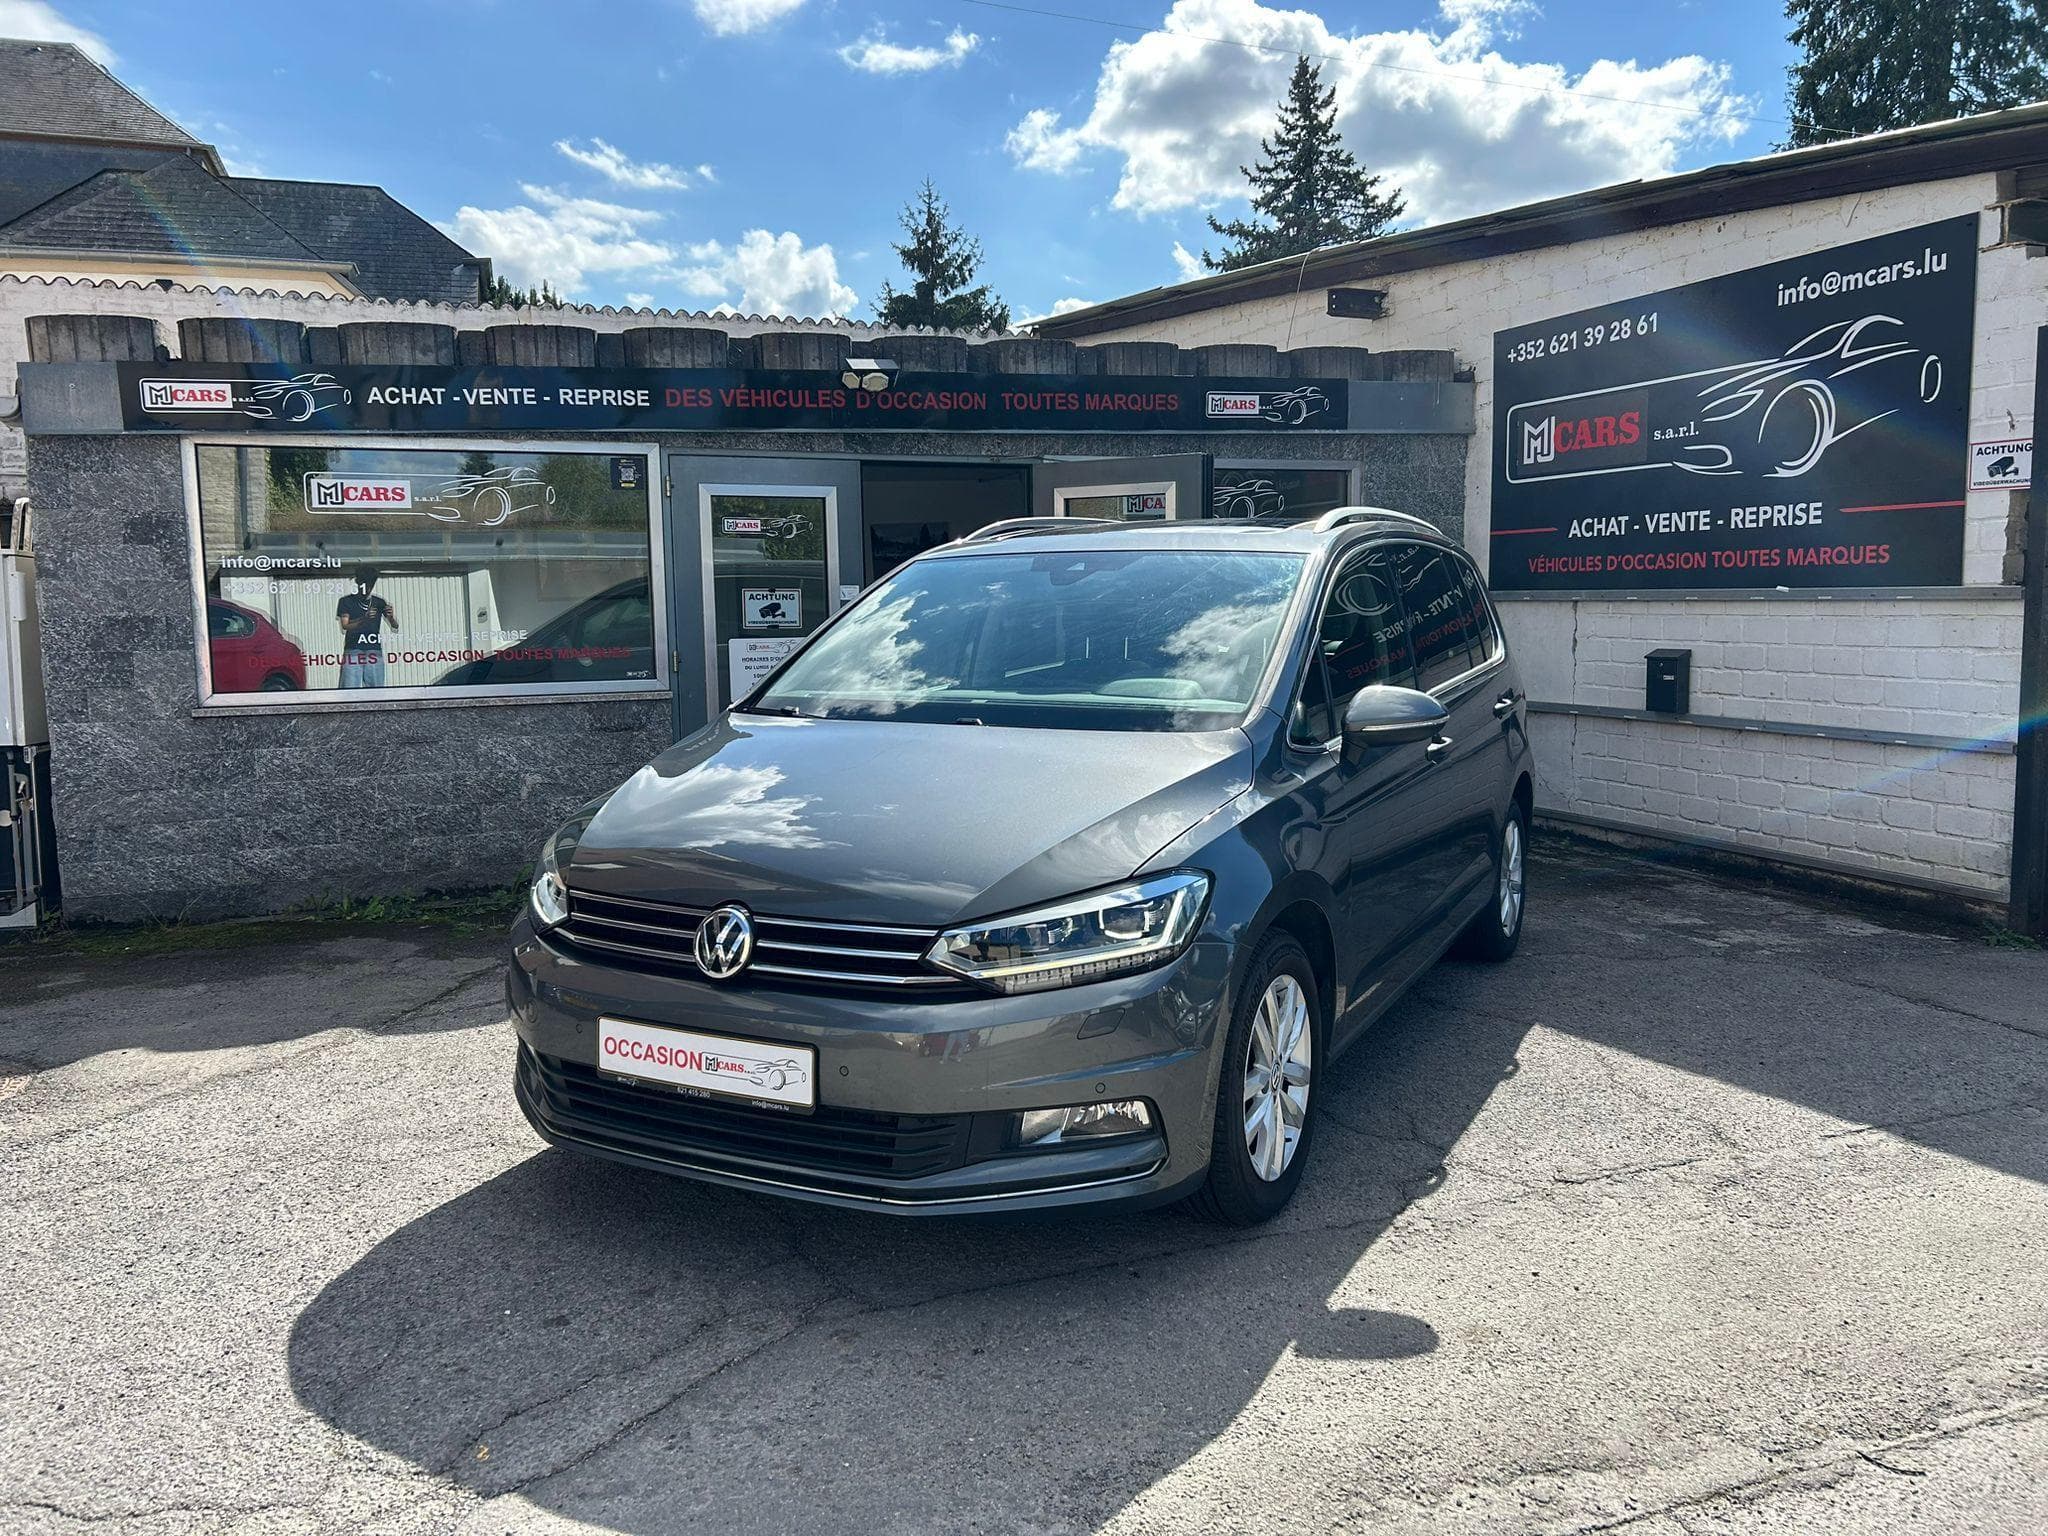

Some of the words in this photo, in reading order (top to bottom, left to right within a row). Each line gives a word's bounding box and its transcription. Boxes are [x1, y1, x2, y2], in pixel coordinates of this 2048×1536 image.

[1777, 248, 1947, 306] info@mcars.lu
[1508, 339, 1545, 362] +352
[1550, 331, 1577, 355] 621
[1584, 325, 1605, 347] 39
[1609, 318, 1631, 342] 28
[1636, 312, 1657, 336] 61
[367, 387, 446, 405] ACHAT
[559, 388, 650, 406] REPRISE
[665, 389, 713, 407] DES
[719, 384, 846, 408] VÉHICULES
[856, 390, 986, 410] D'OCCASION
[1002, 392, 1080, 410] TOUTES
[1086, 393, 1179, 411] MARQUES
[1653, 421, 1699, 441] s.a.r.l.
[1976, 443, 2033, 456] ACHTUNG
[1568, 515, 1629, 538] ACHAT
[1645, 510, 1711, 534] VENTE
[1730, 502, 1823, 529] REPRISE
[222, 555, 341, 571] info@mcars.lu
[1529, 554, 1602, 574] VÉHICULES
[1607, 550, 1707, 571] D'OCCASION
[1712, 548, 1780, 568] TOUTES
[1786, 544, 1890, 566] MARQUES
[269, 582, 296, 594] 621
[748, 593, 796, 601] ACHTUNG
[387, 649, 484, 664] D'OCCASION
[495, 649, 554, 661] TOUTES
[604, 1036, 702, 1070] OCCASION
